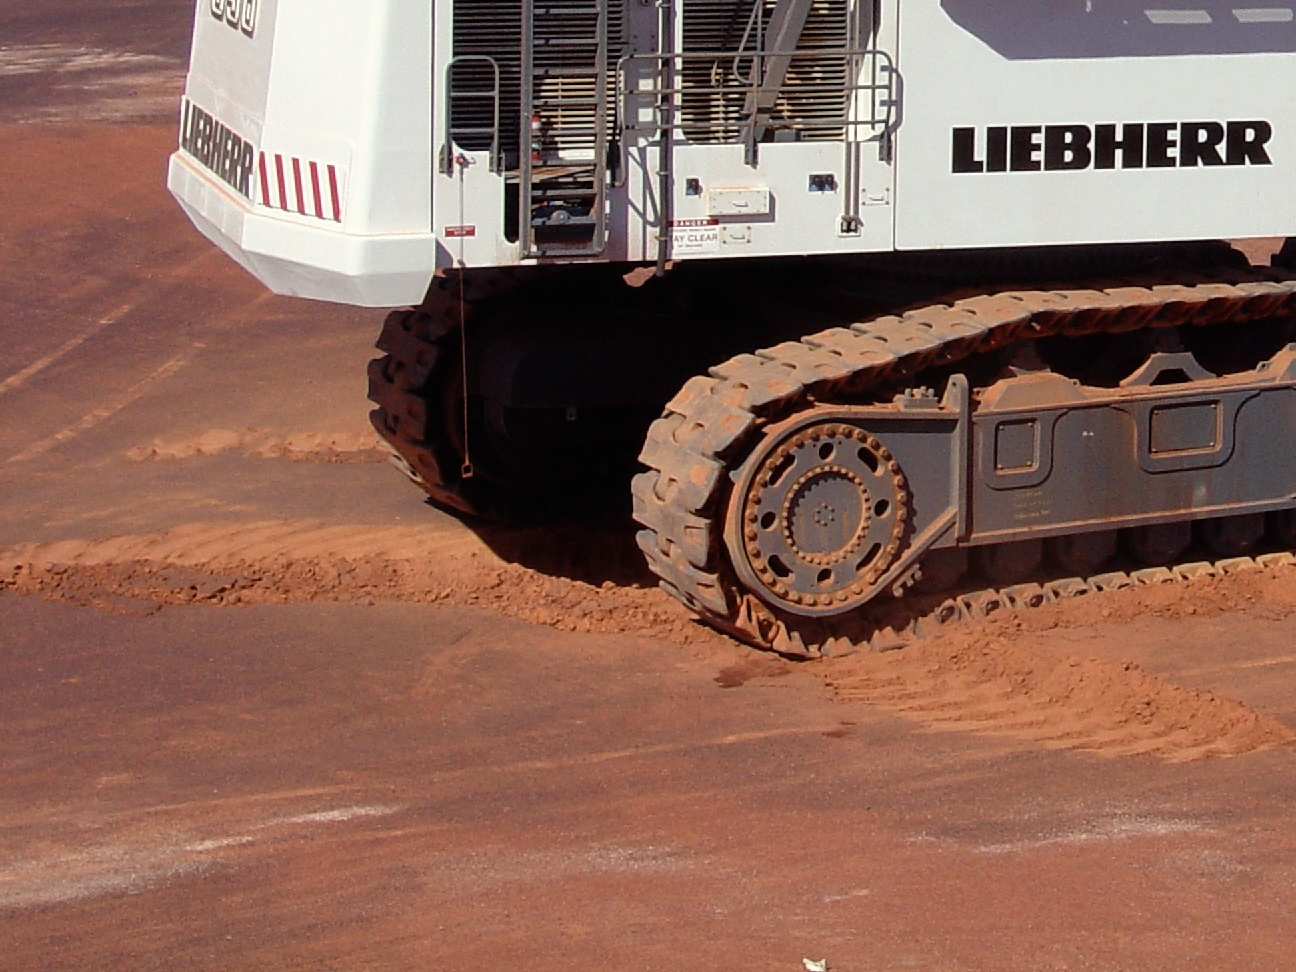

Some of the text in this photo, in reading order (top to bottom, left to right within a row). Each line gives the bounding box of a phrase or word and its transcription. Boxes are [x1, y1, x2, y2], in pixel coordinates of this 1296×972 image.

[181, 98, 253, 200] LIEBHERR
[951, 121, 1273, 173] LIEBHERR
[687, 233, 718, 242] CLEAR
